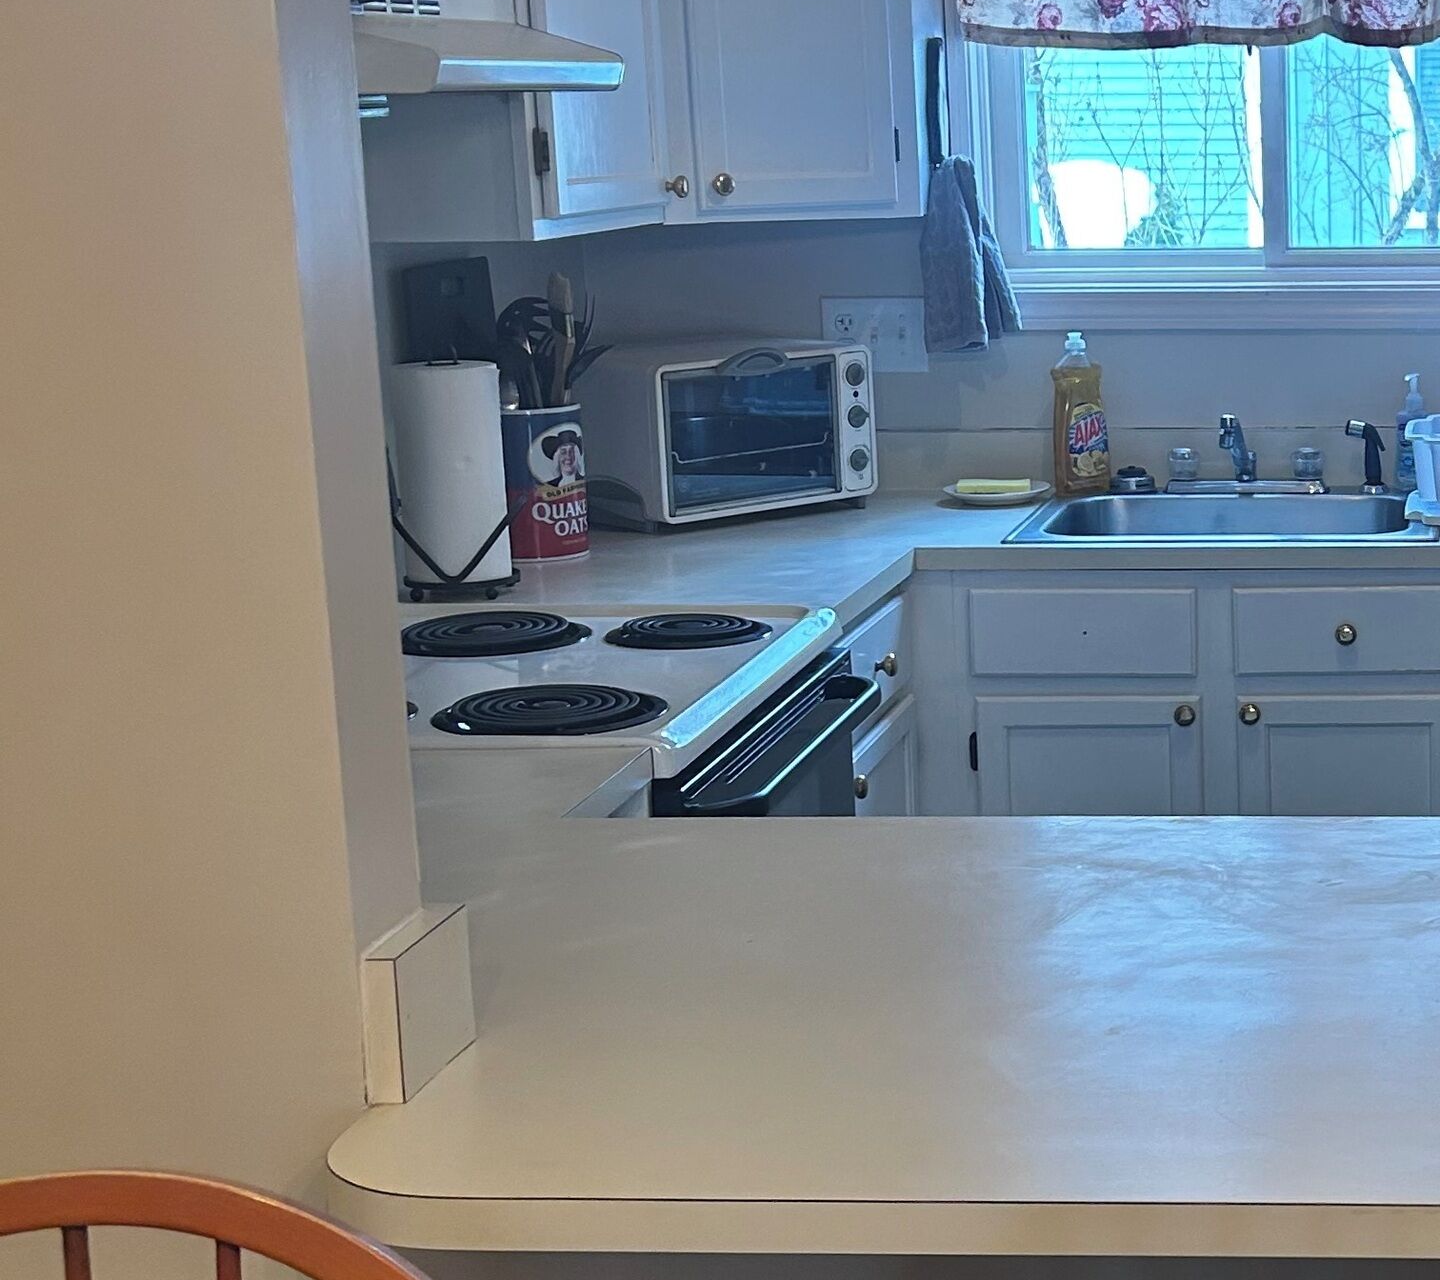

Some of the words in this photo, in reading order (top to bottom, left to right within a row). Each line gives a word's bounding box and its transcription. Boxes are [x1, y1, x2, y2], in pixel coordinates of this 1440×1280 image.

[1074, 415, 1104, 447] AJAX
[546, 490, 562, 498] OLD
[532, 499, 588, 524] QUAKE
[555, 516, 588, 536] OATS
